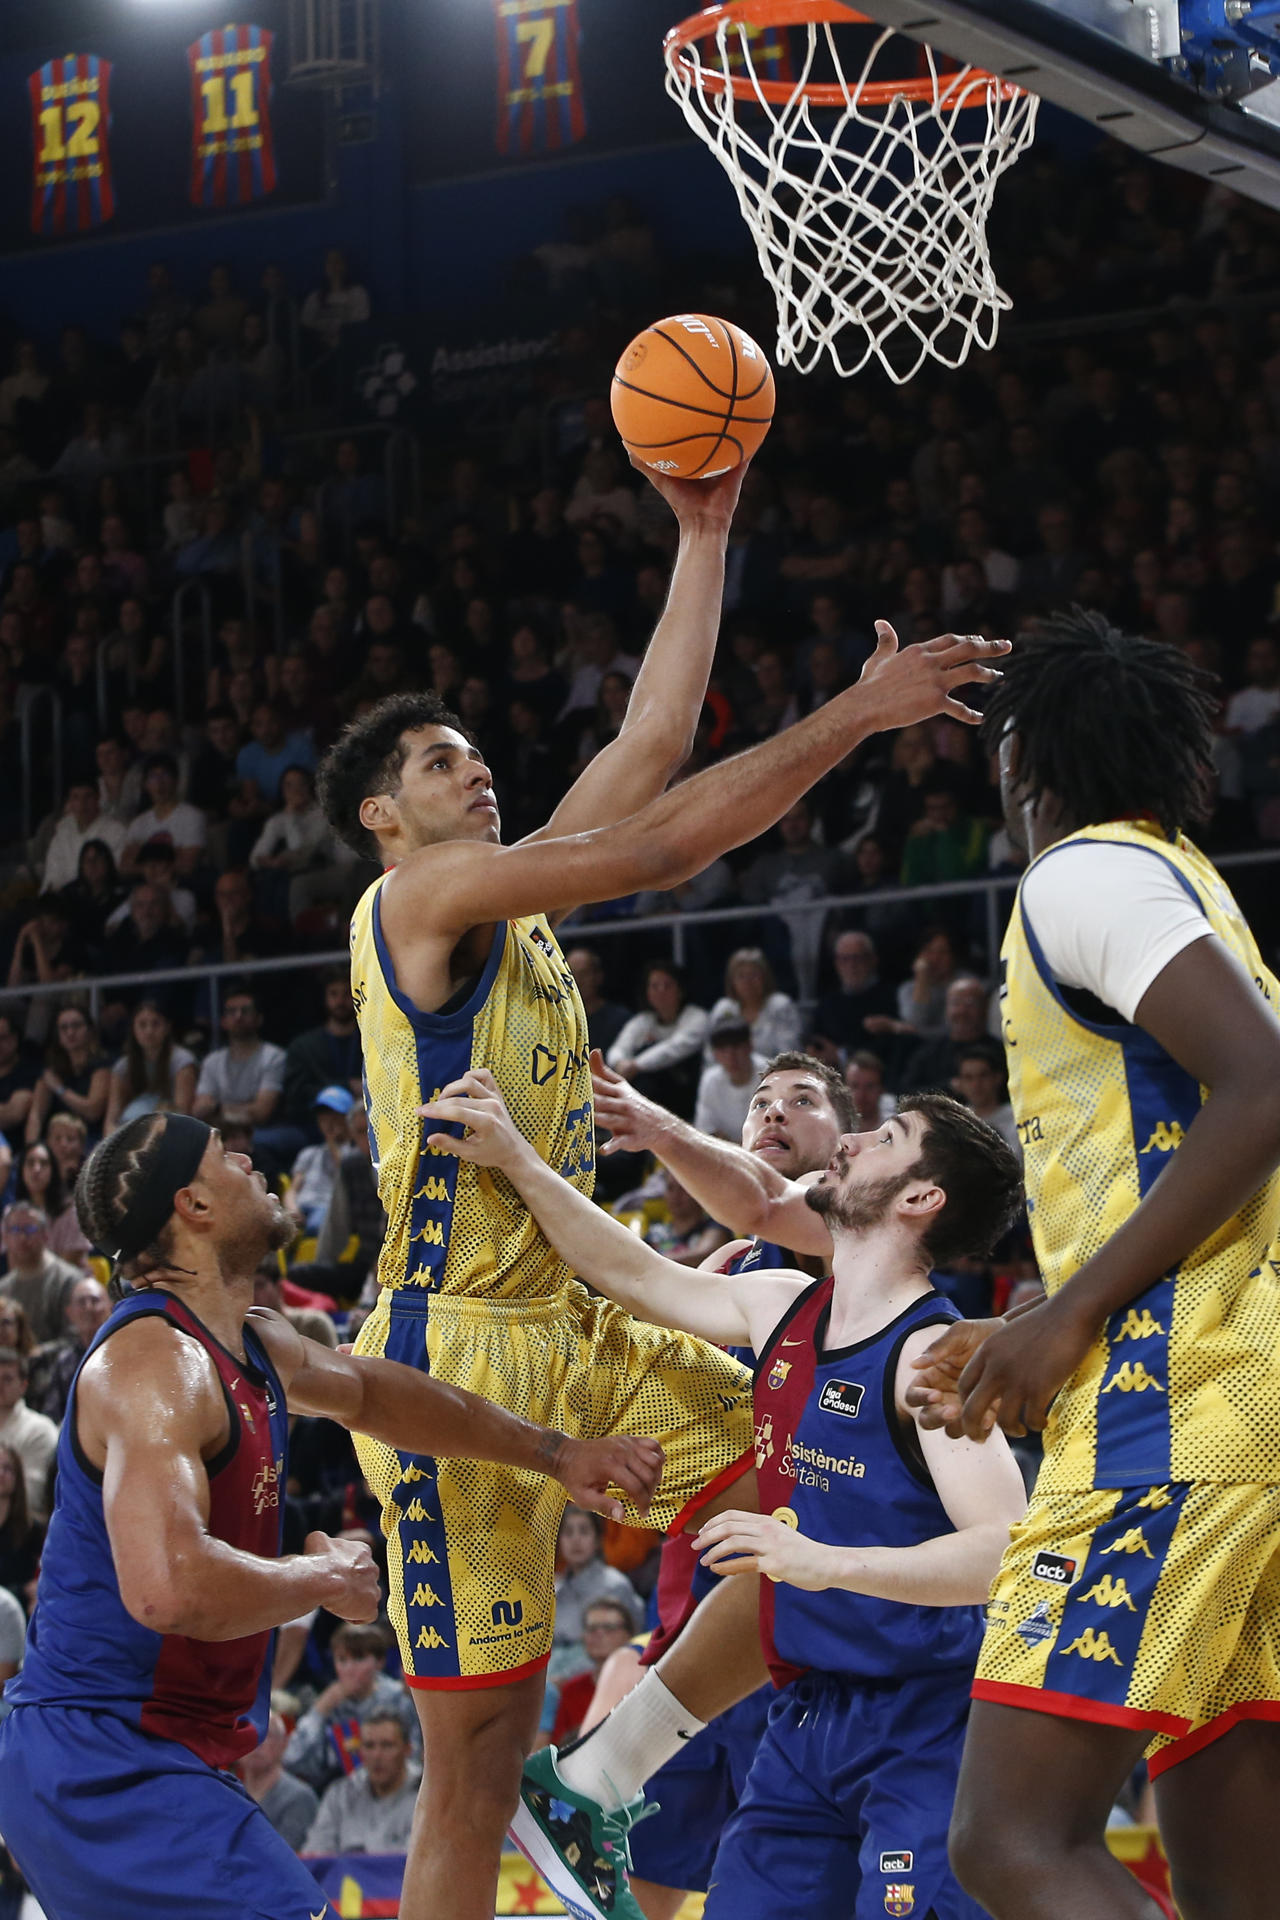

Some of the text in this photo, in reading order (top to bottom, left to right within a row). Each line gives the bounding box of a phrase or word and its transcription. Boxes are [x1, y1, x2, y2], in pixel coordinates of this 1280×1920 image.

[515, 18, 555, 78] 7
[201, 71, 259, 134] 11
[39, 101, 100, 163] 12
[822, 1397, 856, 1414] endesa
[825, 1387, 842, 1400] liga
[785, 1433, 866, 1479] Asistència
[778, 1454, 830, 1493] Saitària
[1036, 1563, 1067, 1581] acb
[469, 1621, 545, 1646] Andorra la Vella
[883, 1858, 905, 1870] acb
